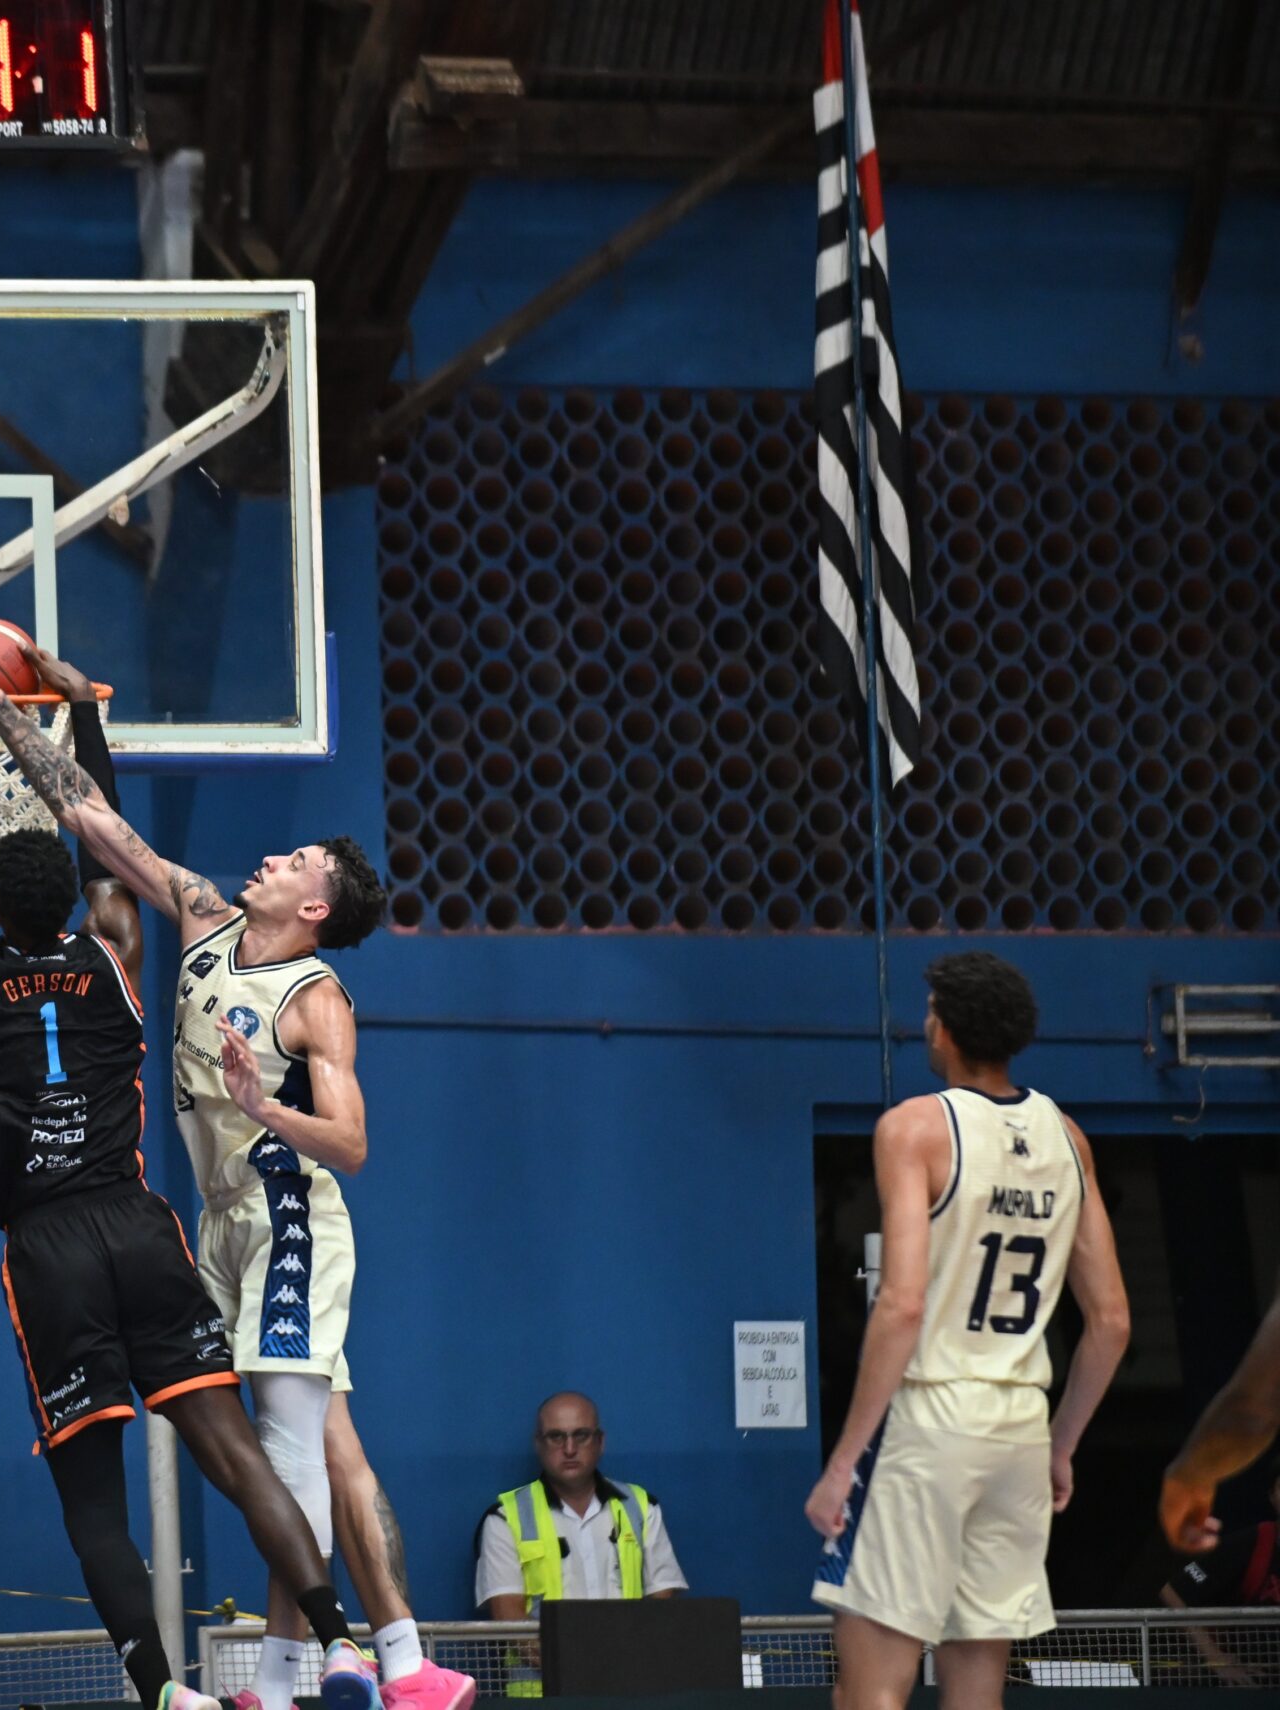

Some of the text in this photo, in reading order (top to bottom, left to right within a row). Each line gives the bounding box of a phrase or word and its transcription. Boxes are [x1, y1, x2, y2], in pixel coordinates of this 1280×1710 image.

[2, 972, 93, 1003] GERSON
[39, 1002, 68, 1085] 1
[987, 1185, 1055, 1219] MURILO
[967, 1232, 1046, 1334] 13
